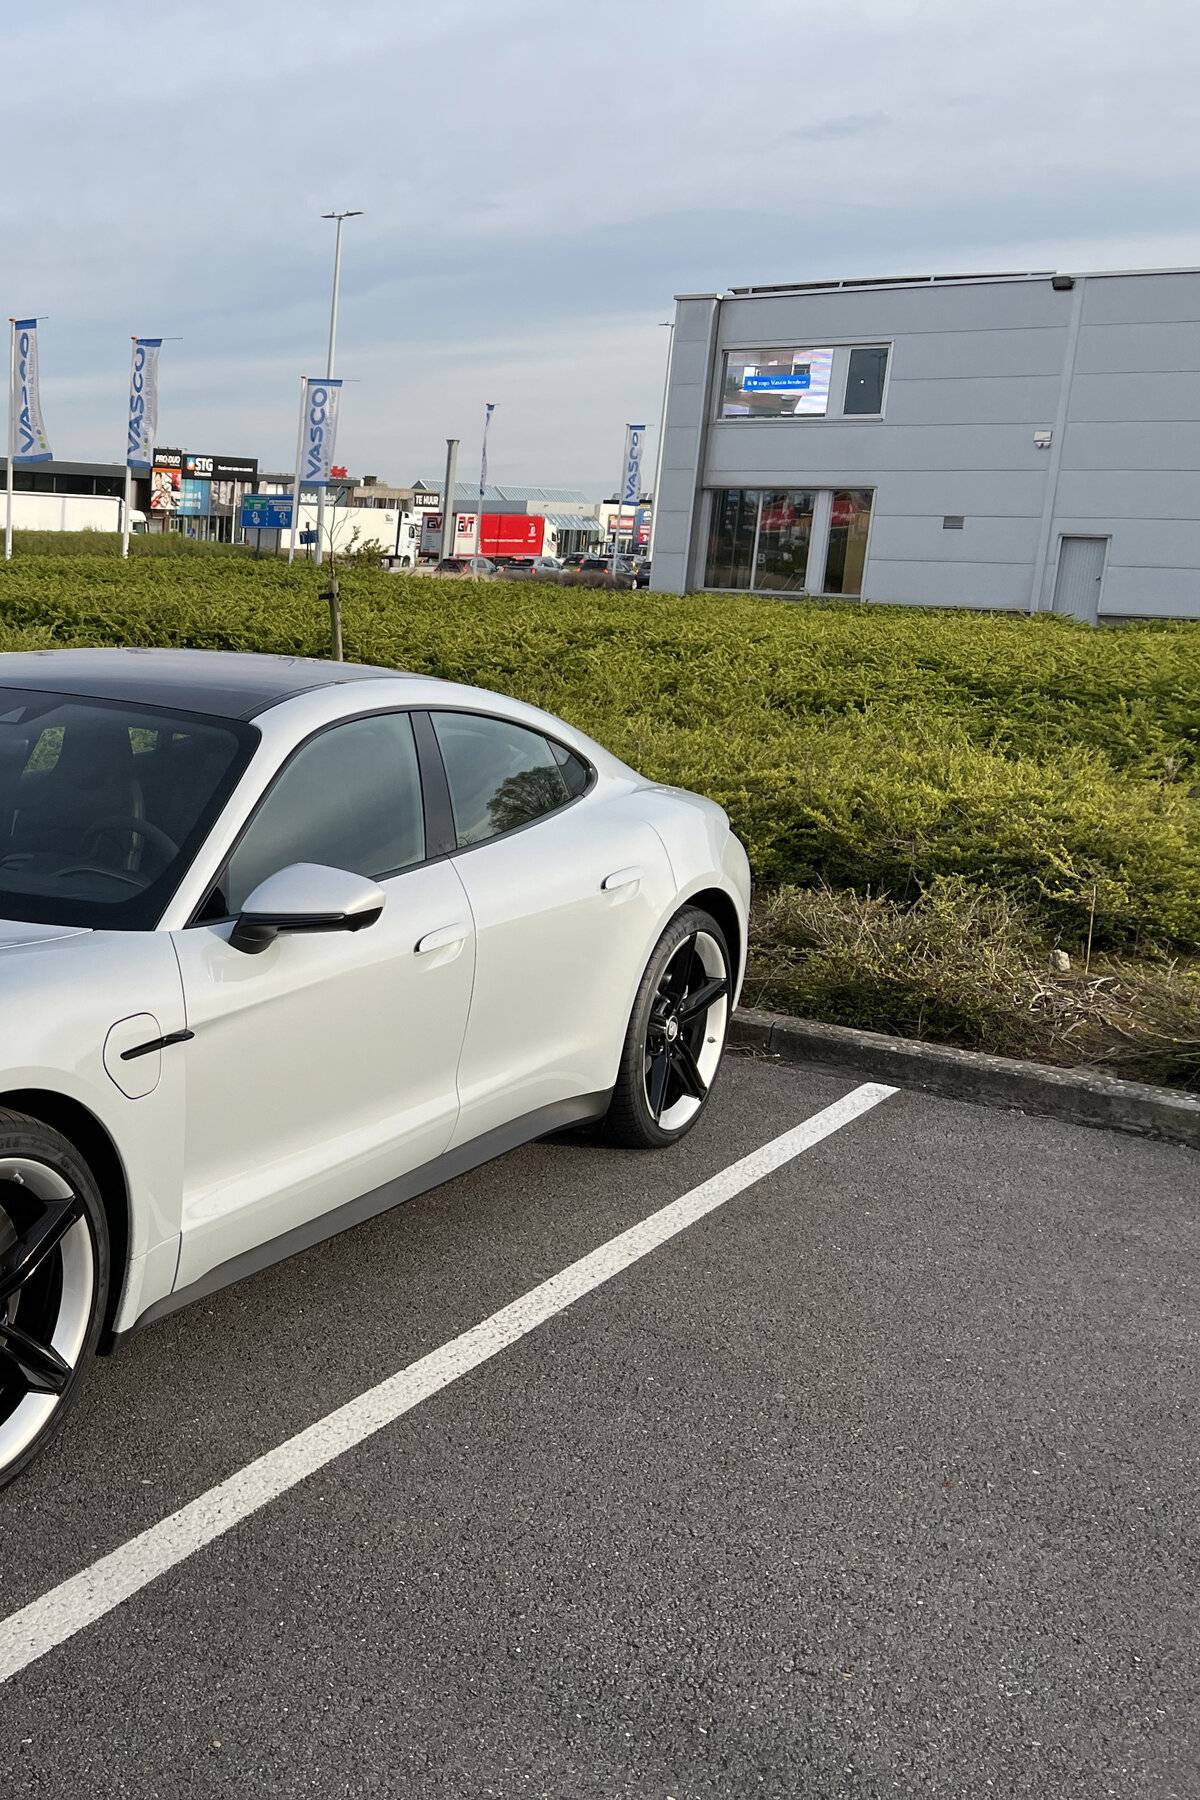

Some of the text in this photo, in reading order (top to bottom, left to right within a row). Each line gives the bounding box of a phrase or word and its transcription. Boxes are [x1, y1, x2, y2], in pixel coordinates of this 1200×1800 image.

[306, 388, 327, 479] VASCO
[195, 457, 214, 471] STG
[626, 432, 638, 499] VASCO
[415, 495, 439, 505] TE HUUR
